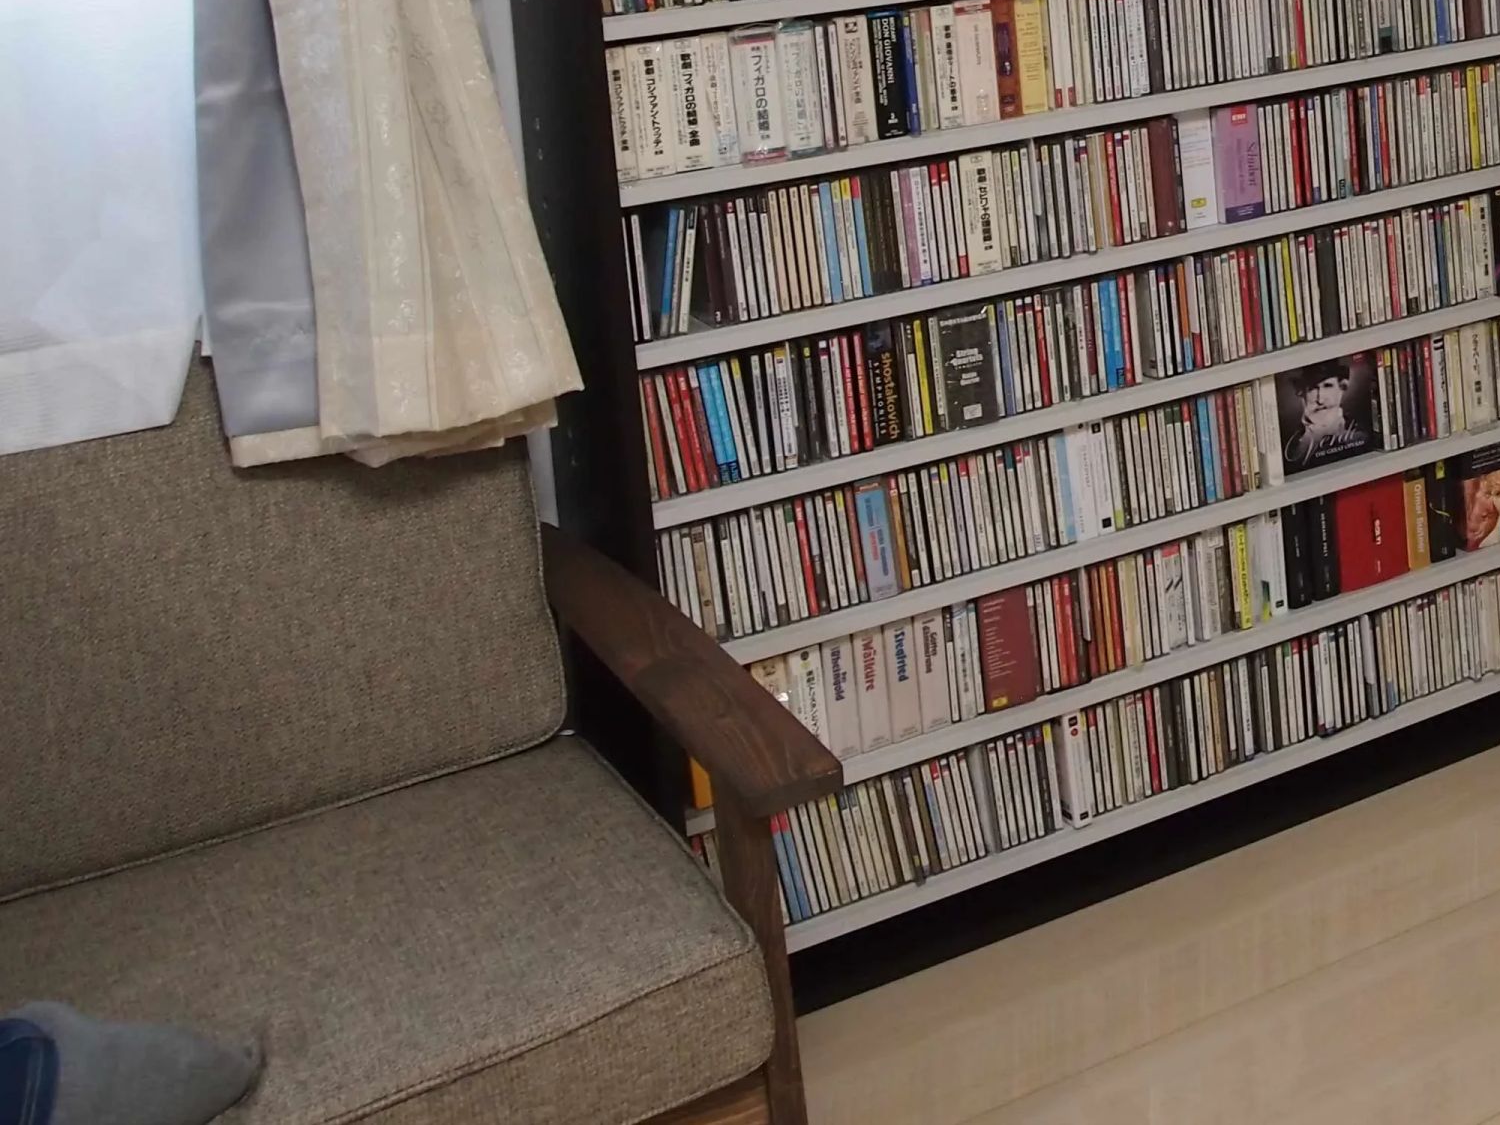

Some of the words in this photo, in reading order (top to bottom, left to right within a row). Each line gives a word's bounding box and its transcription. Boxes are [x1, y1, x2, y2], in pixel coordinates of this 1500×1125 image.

[881, 17, 891, 38] DON
[883, 39, 896, 84] GIOVANNI
[873, 361, 887, 436] SYMPHONIES
[881, 351, 901, 440] shostakovich
